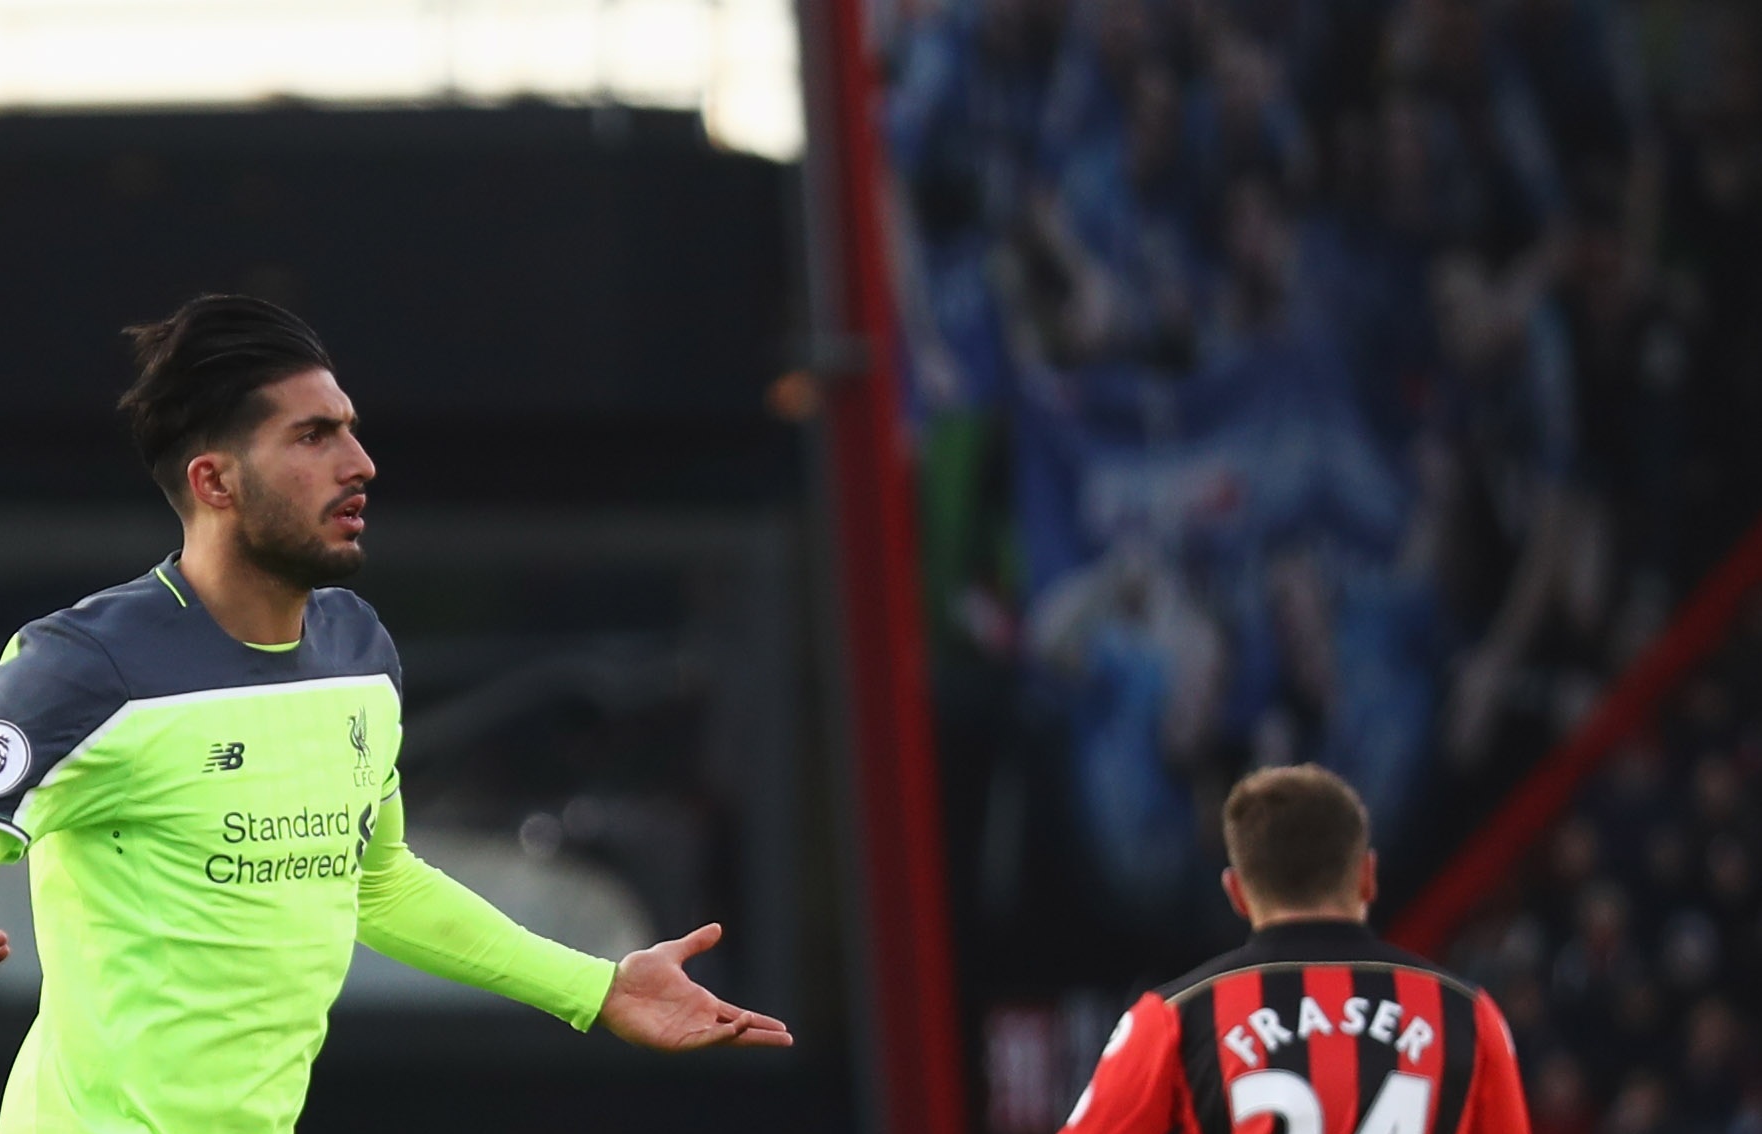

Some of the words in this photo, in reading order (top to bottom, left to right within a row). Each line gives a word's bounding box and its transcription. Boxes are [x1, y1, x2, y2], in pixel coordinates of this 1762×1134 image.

[222, 803, 350, 843] Standard
[205, 846, 349, 884] Chartered
[1222, 996, 1435, 1068] FRASER
